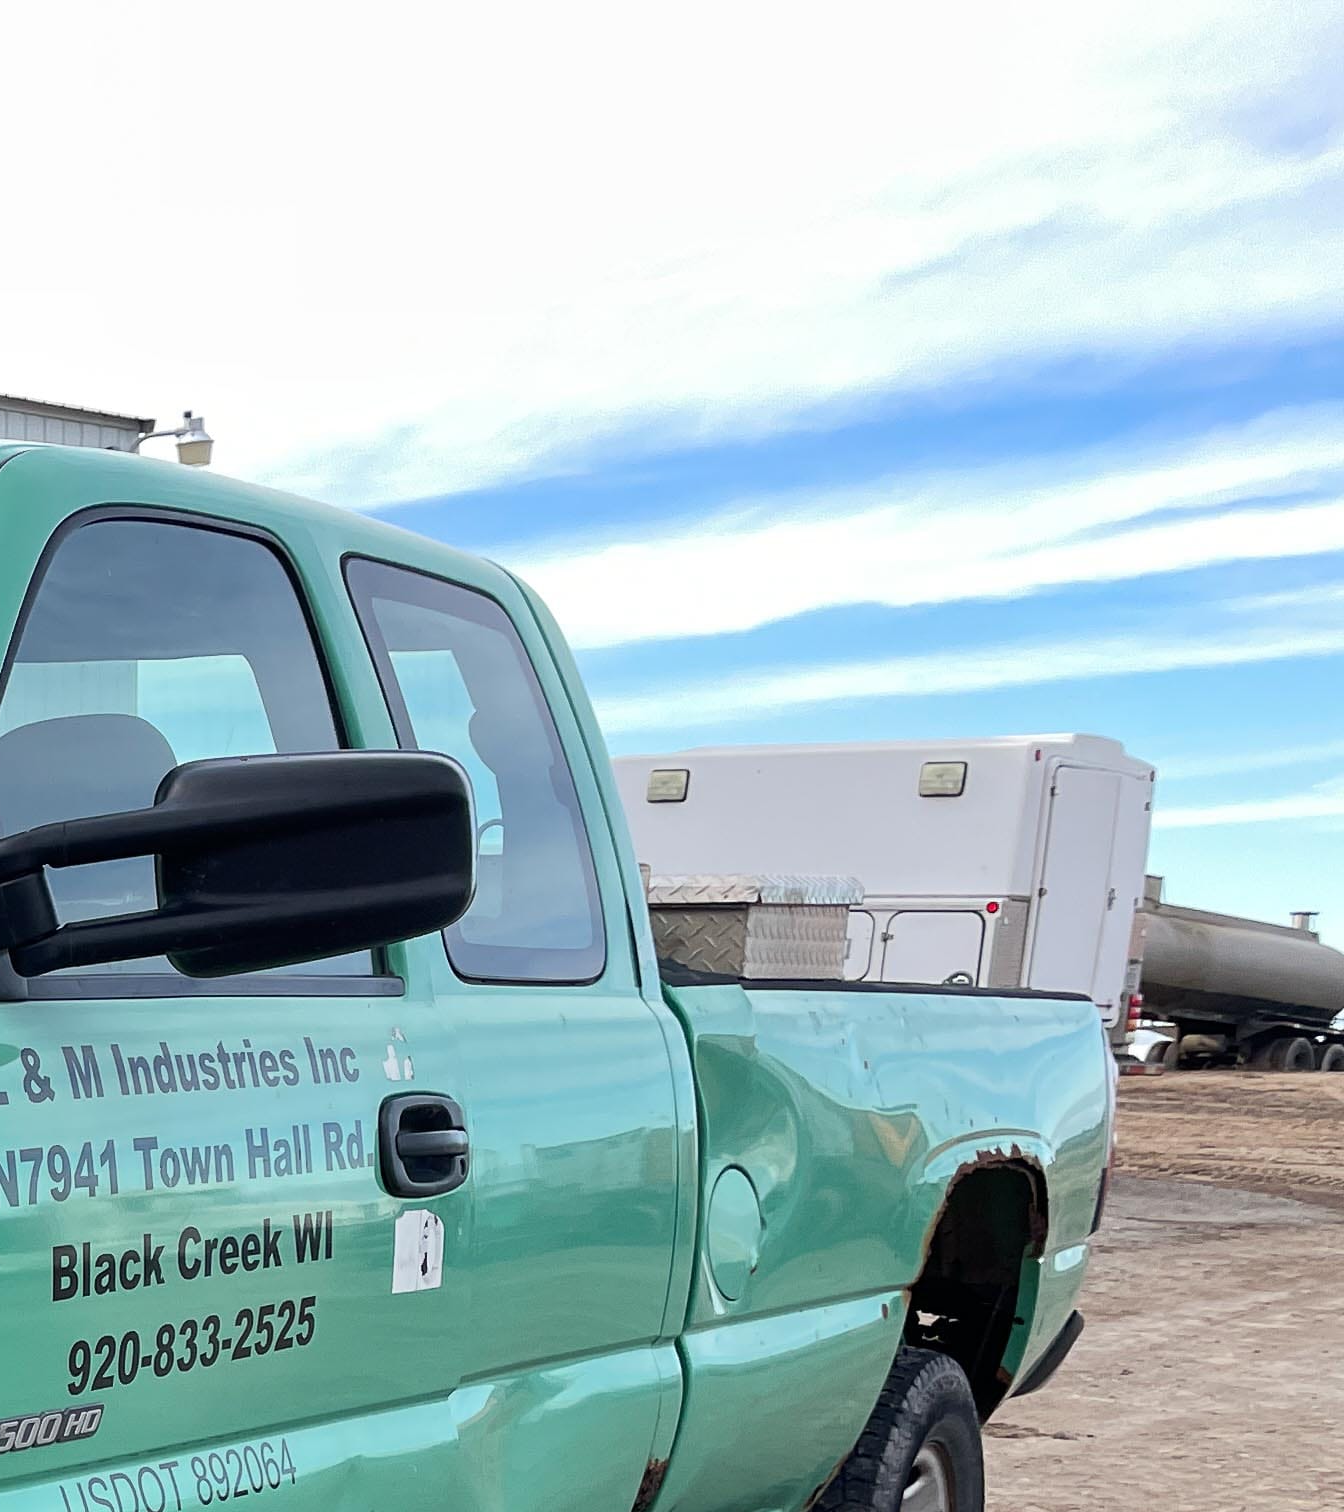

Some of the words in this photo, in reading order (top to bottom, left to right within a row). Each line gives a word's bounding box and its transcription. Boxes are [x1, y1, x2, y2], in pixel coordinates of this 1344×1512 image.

[21, 1046, 55, 1104] &
[62, 1043, 103, 1099] M
[111, 1039, 300, 1096] Industries
[303, 1036, 360, 1084] Inc
[133, 1133, 235, 1190] Town
[244, 1125, 312, 1178] Hall
[323, 1120, 375, 1170] Rd.
[52, 1233, 165, 1301] Black
[177, 1216, 283, 1280] Creek
[293, 1210, 333, 1263] WI
[68, 1296, 316, 1396] 920-833-2525
[63, 1408, 103, 1437] HD
[194, 1437, 297, 1508] 892064
